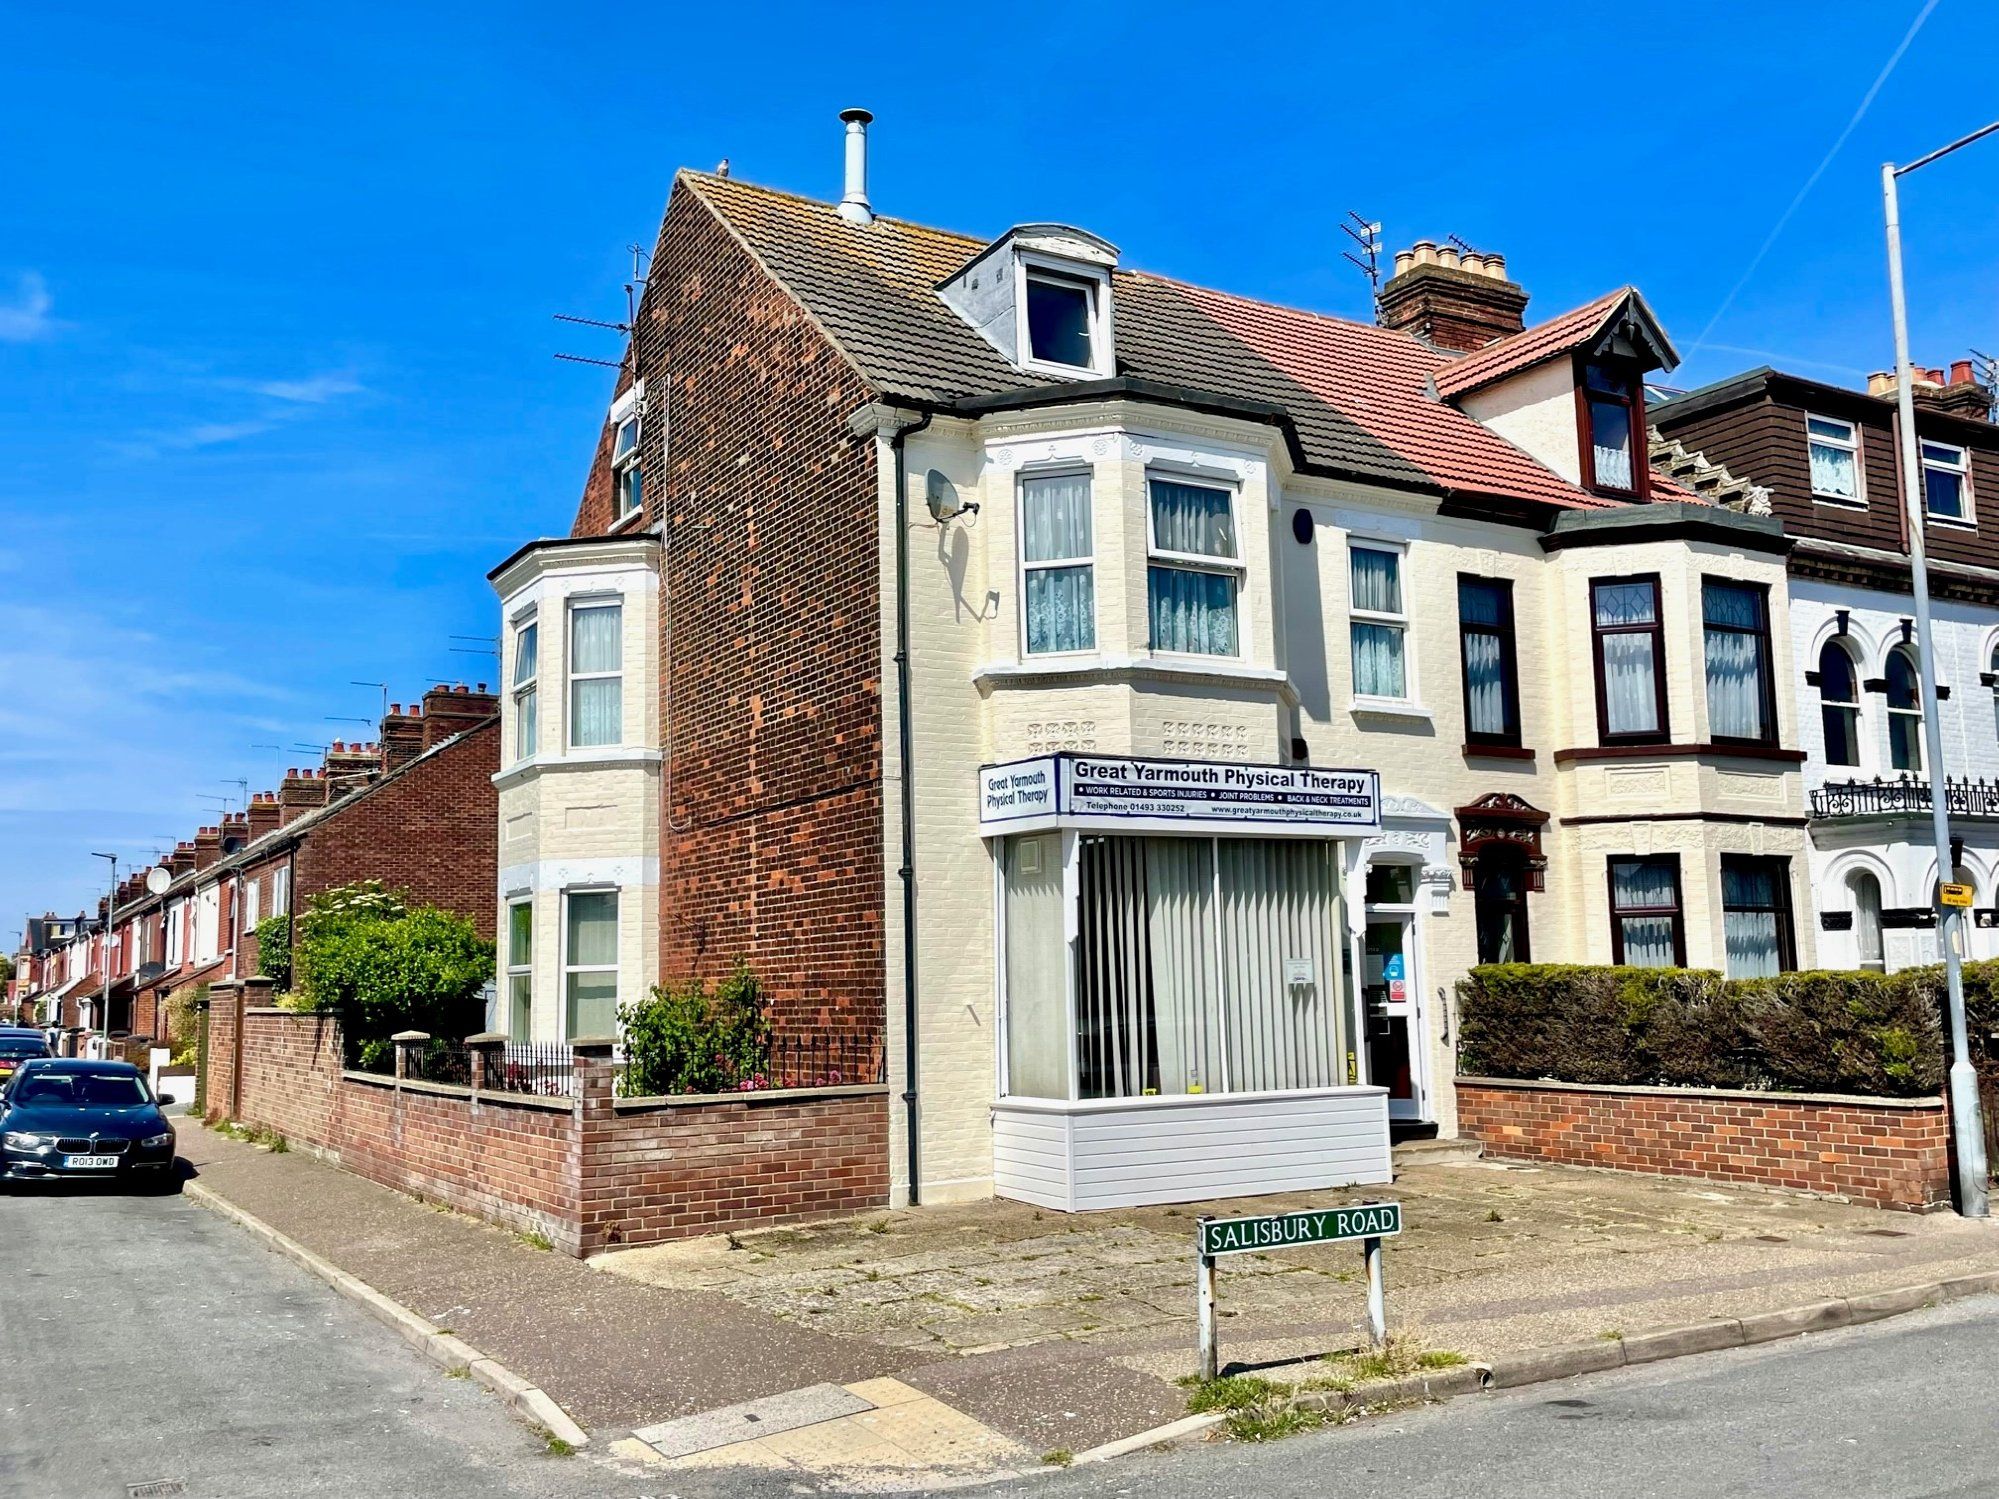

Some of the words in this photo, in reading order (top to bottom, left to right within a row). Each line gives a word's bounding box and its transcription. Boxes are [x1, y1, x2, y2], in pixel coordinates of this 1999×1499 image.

[988, 777, 1008, 791] Great
[1010, 770, 1045, 787] Yarmouth
[1075, 761, 1127, 779] Great
[1134, 765, 1217, 783] Yarmouth
[1224, 768, 1295, 788] Physical
[1300, 772, 1365, 793] Therapy
[987, 792, 1015, 809] Physical
[1017, 787, 1048, 804] Therapy
[1085, 786, 1109, 794] WORK
[1109, 787, 1141, 796] RELATED
[1142, 788, 1148, 796] &
[1149, 788, 1176, 797] SPORTS
[1177, 790, 1207, 798] INJURIES
[1218, 791, 1239, 800] JOINT
[1239, 793, 1274, 801] PROBLEMS
[1287, 795, 1305, 803] BACK
[1311, 797, 1328, 805] NECK
[1329, 798, 1369, 806] TREATMENTS
[1086, 801, 1128, 811] Telephone
[1130, 803, 1154, 811] 01493
[1156, 804, 1185, 812] 330252
[1211, 806, 1362, 818] www.greatyarmouthphysicaltherapy.co.uk
[1210, 1215, 1327, 1250] SALISBURY
[1337, 1209, 1395, 1235] ROAD
